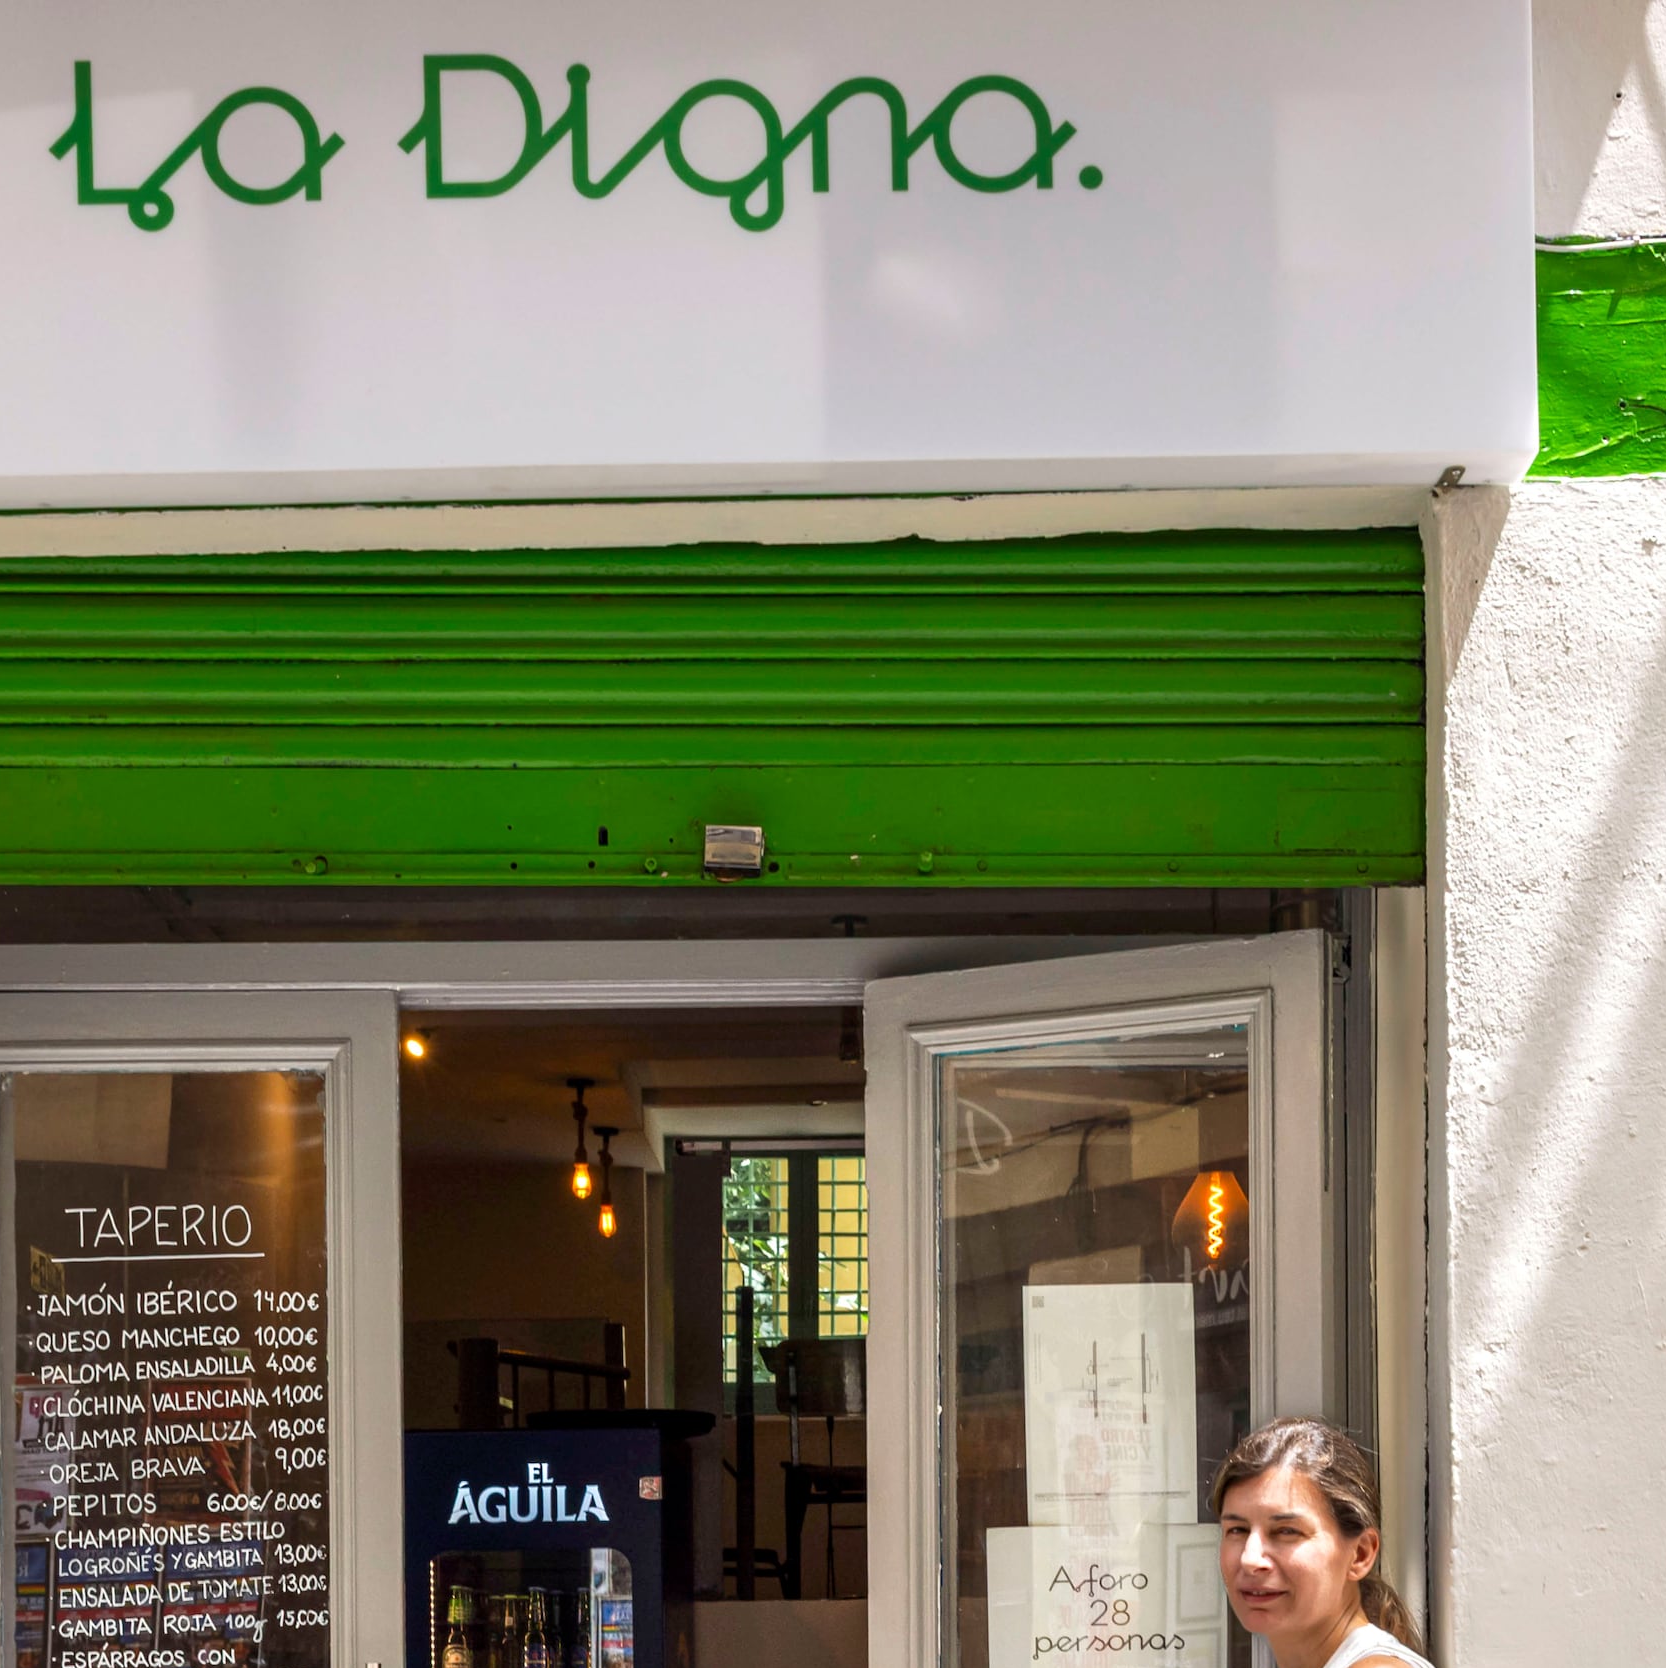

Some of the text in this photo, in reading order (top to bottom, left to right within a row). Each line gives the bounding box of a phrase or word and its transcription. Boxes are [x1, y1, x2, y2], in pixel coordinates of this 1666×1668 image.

[49, 53, 1104, 231] La Digna.
[64, 1204, 252, 1248] TAPERIO
[36, 1280, 319, 1317] JAMÓN IBÉRICO 14,00€
[36, 1325, 318, 1353] QUESO MANCHEGO 10,00€
[41, 1352, 317, 1385] PALOMA ENSALADILLA 4,00€
[43, 1384, 324, 1418] CLÓCHINA VALENCIANA 11,00€
[44, 1417, 326, 1452] CALAMAR ANDALUZA 18,00€
[49, 1446, 327, 1485] OREJA BRAVA 9,00€
[527, 1463, 553, 1484] EL
[53, 1492, 157, 1517] PEPITOS
[448, 1481, 609, 1524] ÁGUILA
[54, 1521, 285, 1551] CHAMPIÑONES ESTILO
[58, 1543, 326, 1578] LOGROÑÉS Y GAMBITA 13,00€
[59, 1583, 164, 1609] ENSALADA
[167, 1581, 194, 1603] DE
[197, 1575, 274, 1600] TOMATE
[1049, 1564, 1148, 1597] Aforo
[58, 1617, 153, 1640] GAMBITA
[163, 1613, 217, 1635] ROJA
[1091, 1599, 1130, 1626] 28
[197, 1648, 236, 1666] CON
[1033, 1633, 1184, 1660] personas
